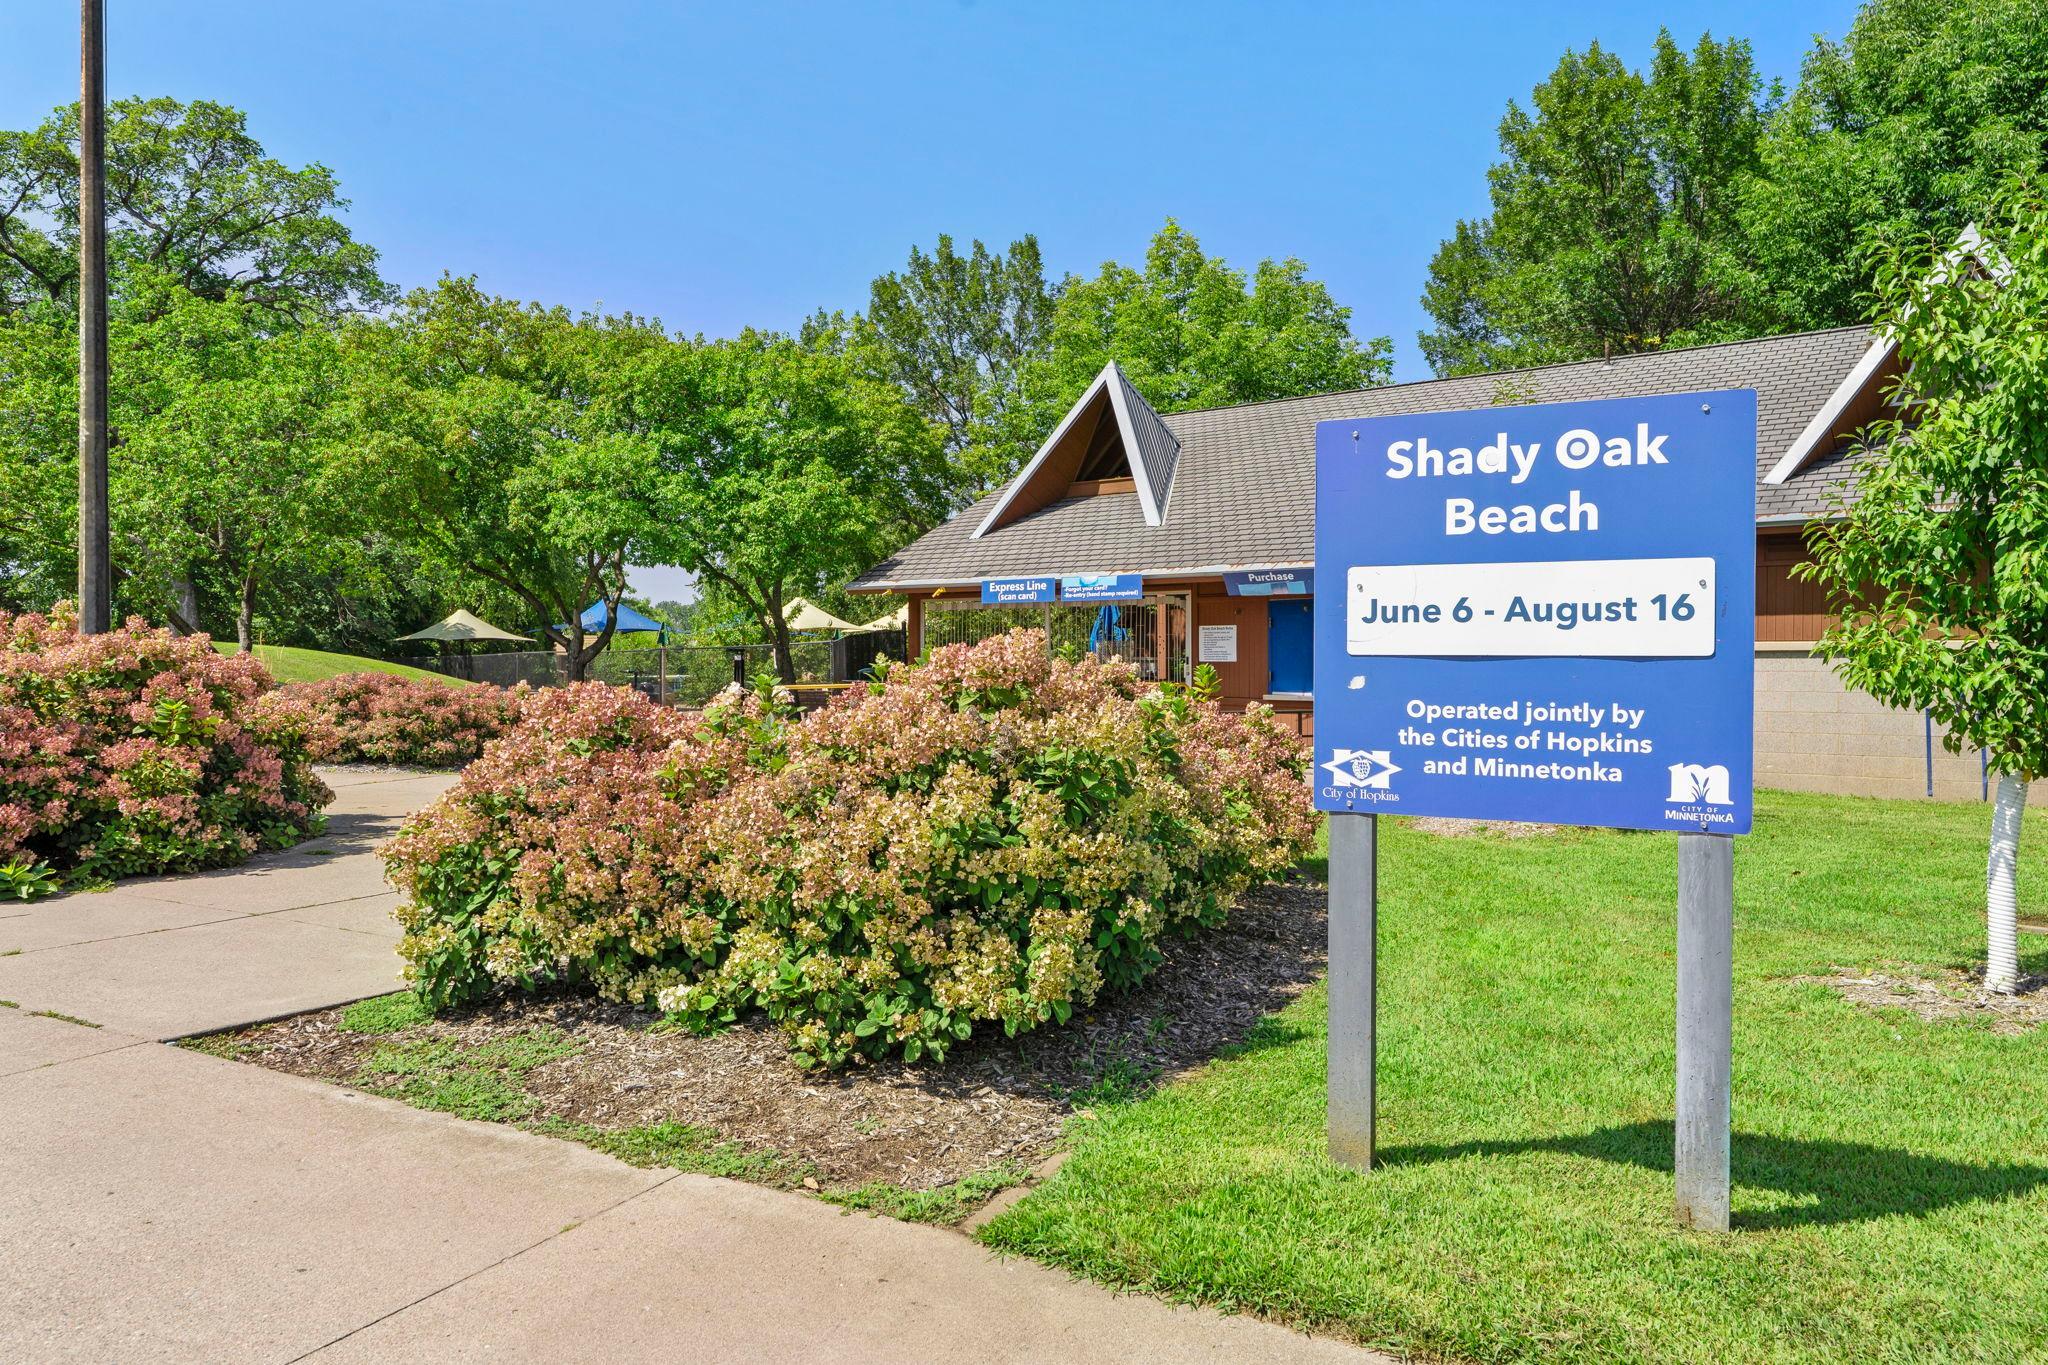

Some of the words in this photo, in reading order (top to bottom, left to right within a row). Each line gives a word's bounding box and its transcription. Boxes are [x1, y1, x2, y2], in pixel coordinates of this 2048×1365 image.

[1386, 433, 1541, 483] Shady
[1556, 423, 1669, 470] Oak
[1446, 490, 1599, 535] Beach
[990, 582, 1024, 593] Express
[1027, 581, 1047, 590] Line
[1248, 572, 1294, 581] Purchase
[998, 593, 1016, 601] (scan
[1018, 592, 1037, 600] card)
[1361, 598, 1441, 624] June
[1452, 597, 1473, 622] 6
[1504, 596, 1637, 630] August
[1650, 594, 1695, 621] 16
[1406, 699, 1518, 725] Operated
[1524, 702, 1605, 727] jointly
[1612, 706, 1644, 728] by
[1398, 728, 1435, 746] the
[1442, 728, 1507, 748] Cities
[1514, 730, 1540, 749] of
[1547, 732, 1653, 757] Hopkins
[1423, 757, 1467, 776] and
[1474, 758, 1622, 782] Minnetonka
[1323, 787, 1343, 801] City
[1346, 788, 1357, 799] of
[1360, 789, 1400, 803] Hopkins
